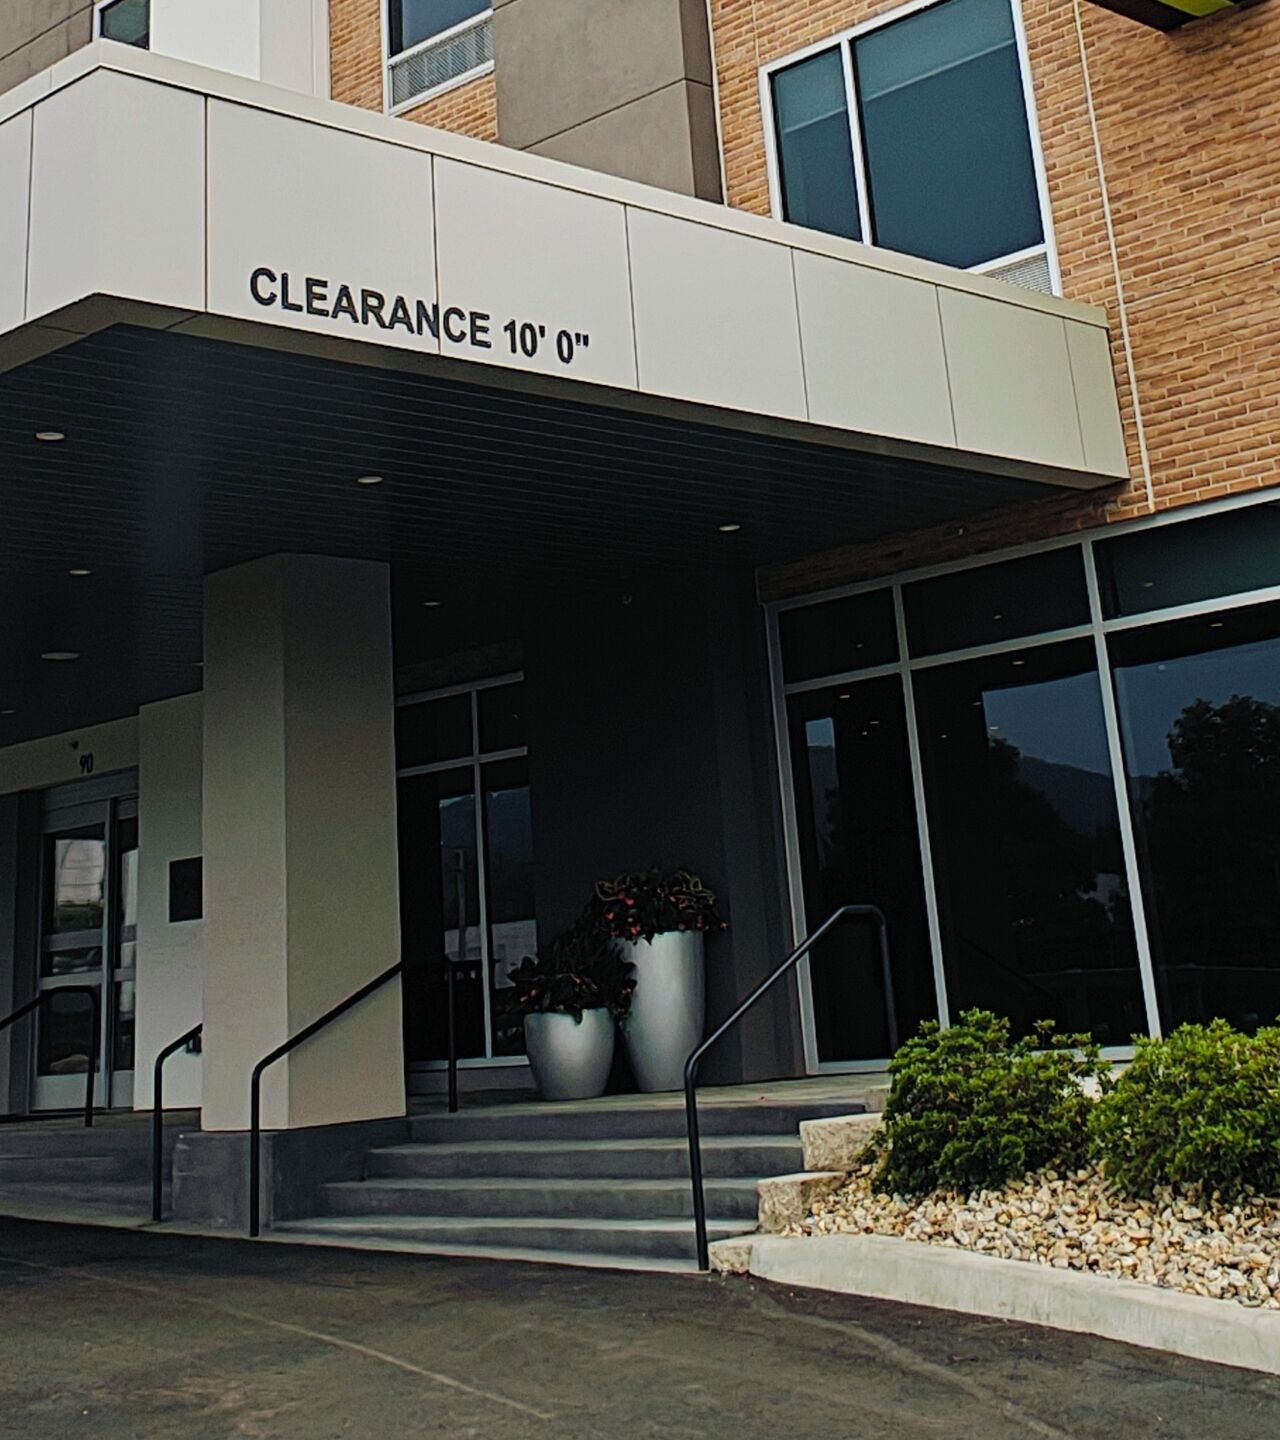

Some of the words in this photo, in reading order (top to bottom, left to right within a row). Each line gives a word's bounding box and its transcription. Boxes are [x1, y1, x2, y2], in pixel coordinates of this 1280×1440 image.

[250, 267, 492, 349] CLEARANCE
[503, 319, 546, 358] 10'
[79, 752, 94, 775] 90
